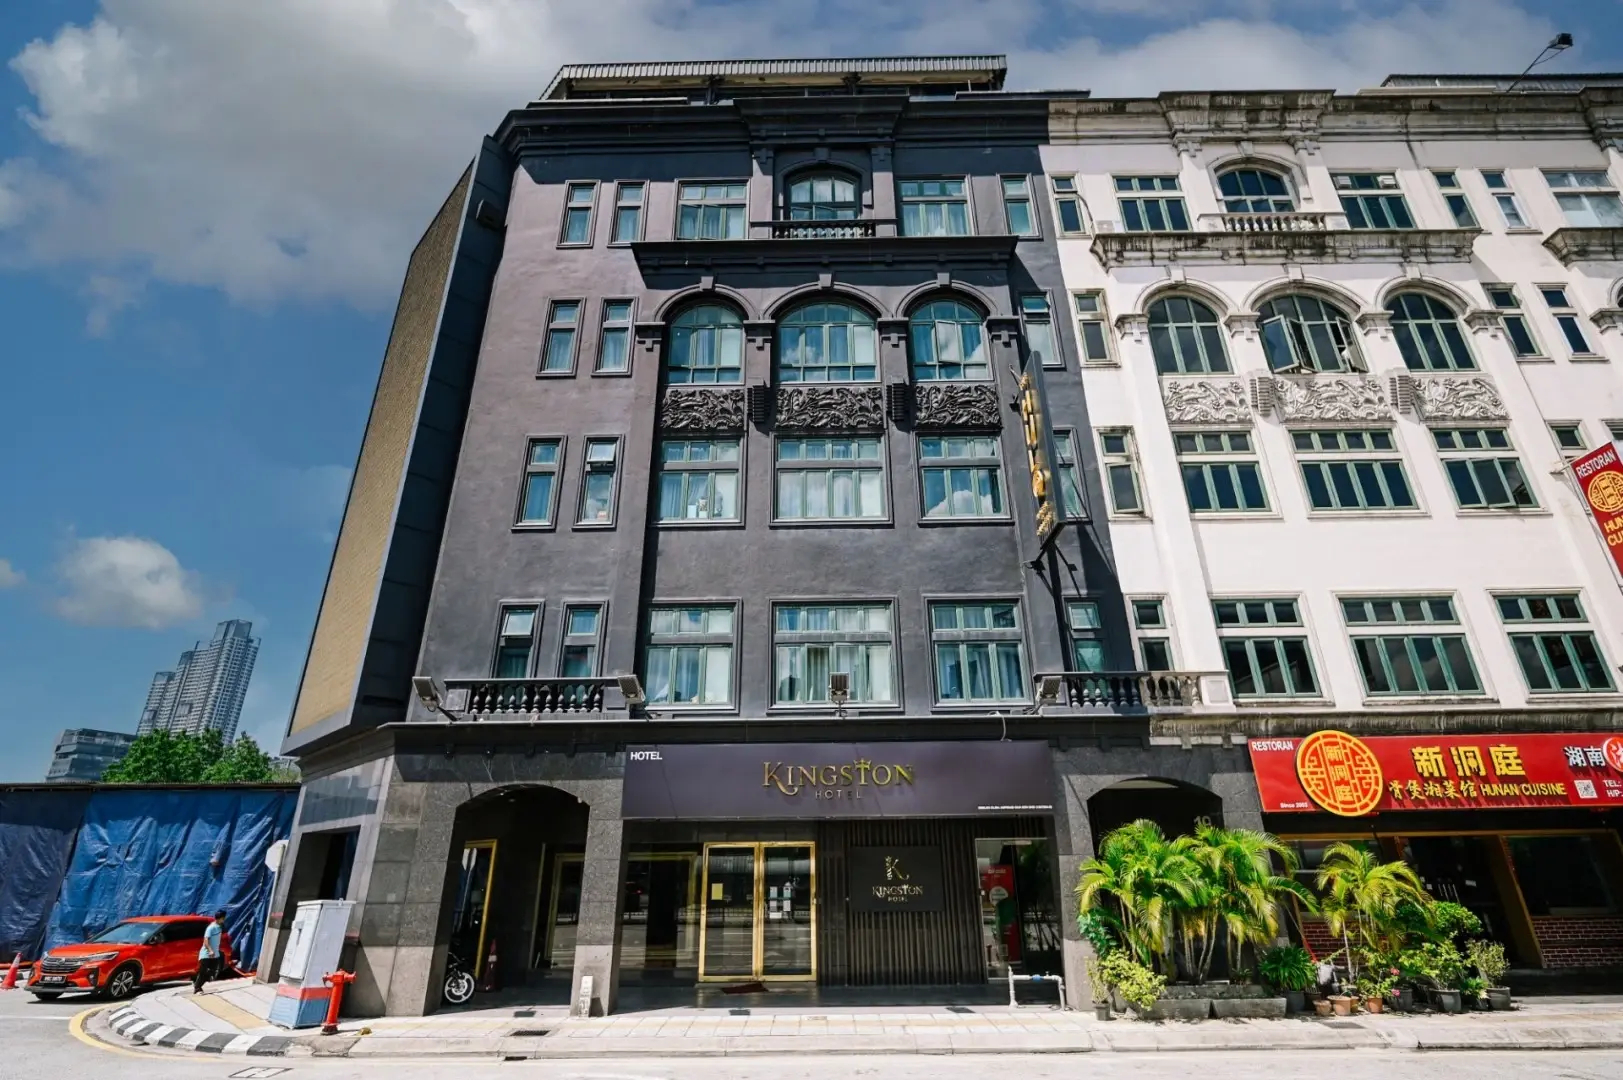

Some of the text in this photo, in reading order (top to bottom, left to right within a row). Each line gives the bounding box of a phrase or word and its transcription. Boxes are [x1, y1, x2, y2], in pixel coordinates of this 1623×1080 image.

[1575, 449, 1617, 479] RESTORAN
[1251, 741, 1294, 751] RESTORAN
[630, 751, 663, 760] HOTEL
[1411, 744, 1526, 777] 新洞庭
[762, 758, 913, 796] KINGSTON
[815, 790, 862, 799] HOTEL
[1480, 784, 1519, 796] HUNAN
[1521, 783, 1567, 796] CUISINE
[872, 884, 923, 898] KINGSTON
